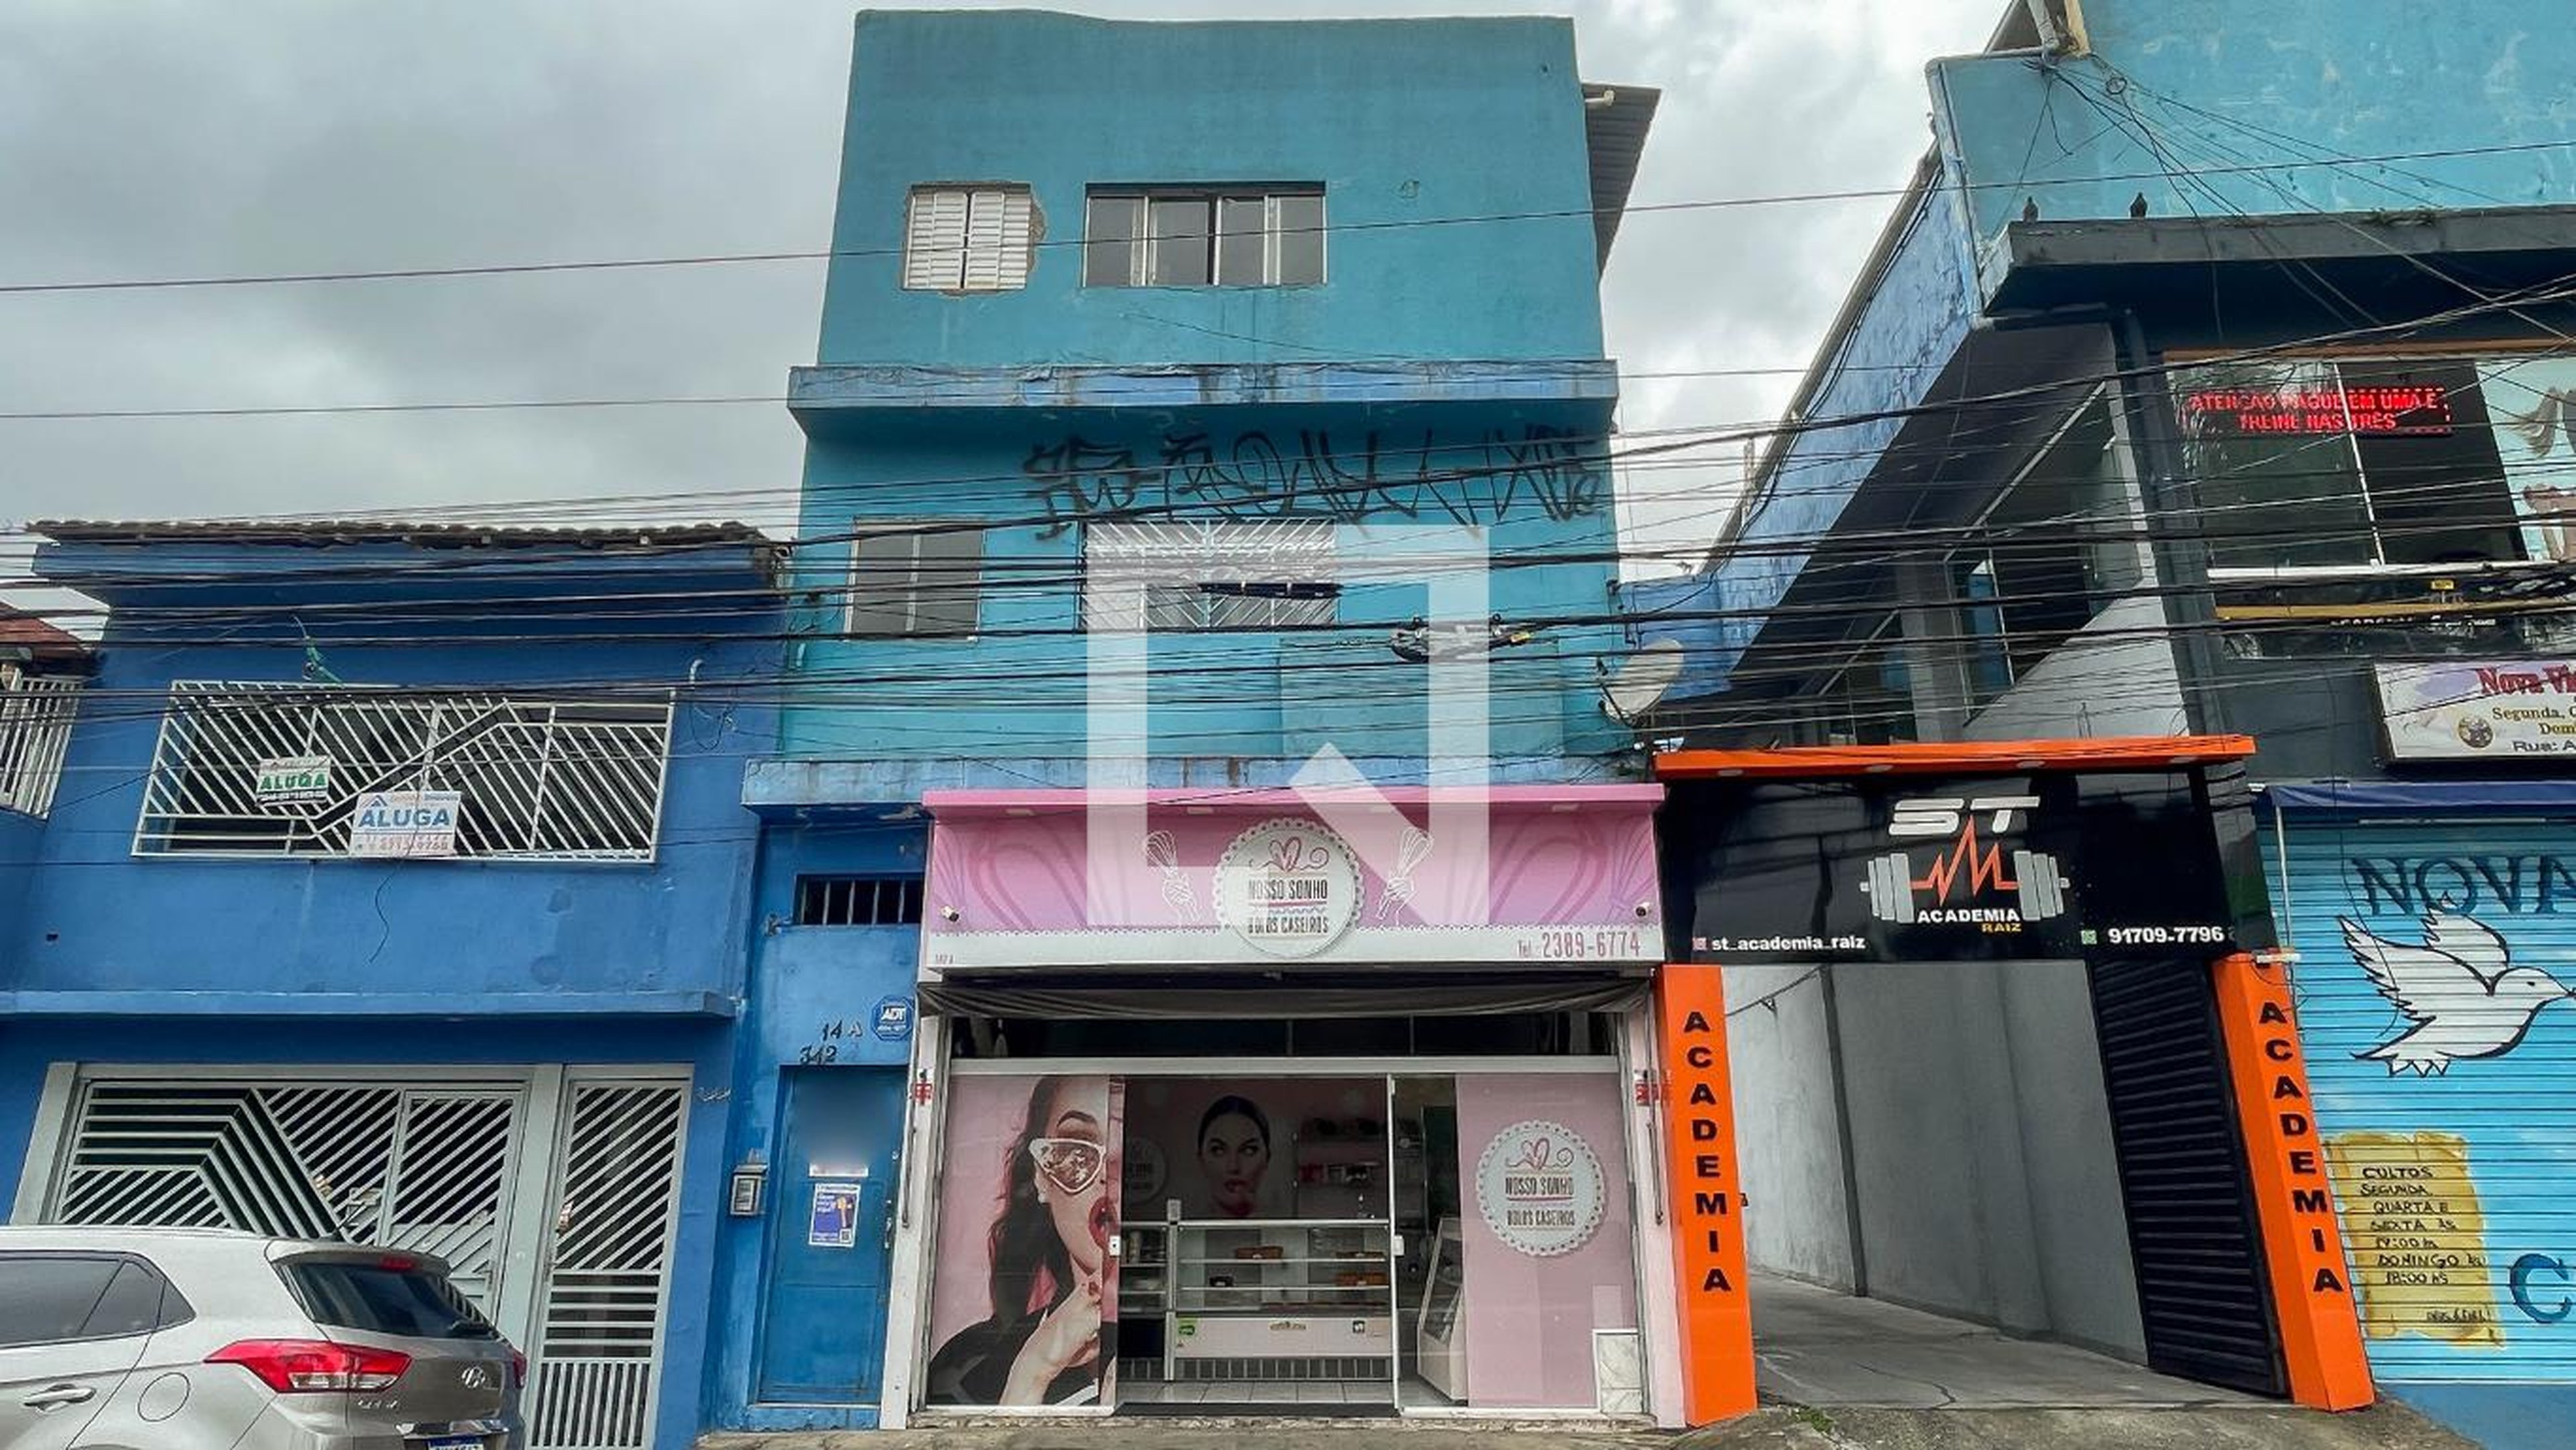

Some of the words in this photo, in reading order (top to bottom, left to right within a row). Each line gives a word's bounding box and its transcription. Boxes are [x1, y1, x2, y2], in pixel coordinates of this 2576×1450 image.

[260, 773, 327, 790] ALUGA
[359, 807, 450, 827] ALUGA
[1888, 796, 2041, 835] ST
[1288, 878, 1328, 900] SONHO
[1281, 915, 1330, 934] CASEIROS
[1917, 908, 2021, 924] ACADEMIA
[1981, 923, 2022, 933] RAIZ
[2108, 926, 2226, 944] 91709-7796
[1542, 931, 1641, 958] 2389-6774
[1712, 935, 1867, 951] st_academia_raiz
[881, 1007, 906, 1020] ADT
[1683, 1011, 1732, 1292] ACADEMIA
[2259, 1002, 2343, 1292] ACADEMIA
[2361, 1166, 2434, 1180] CULTOS
[1505, 1177, 1537, 1195] NOSSO
